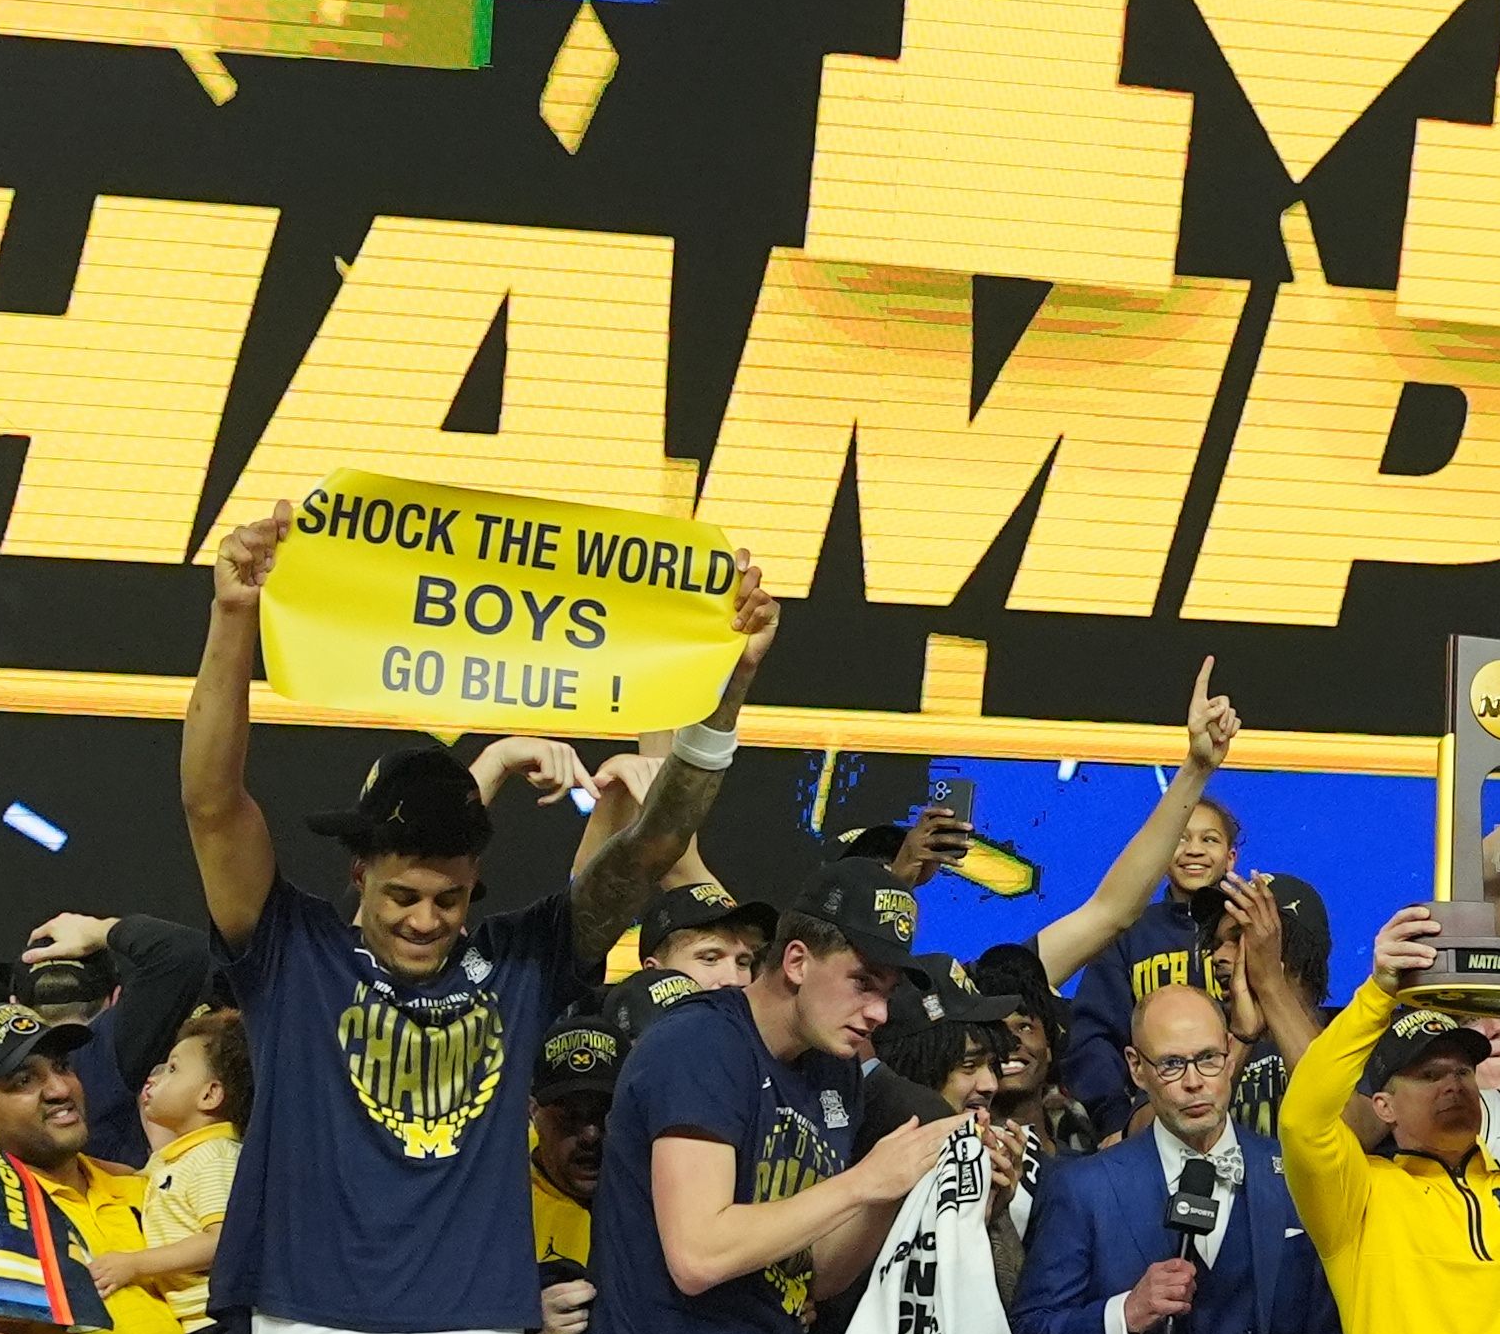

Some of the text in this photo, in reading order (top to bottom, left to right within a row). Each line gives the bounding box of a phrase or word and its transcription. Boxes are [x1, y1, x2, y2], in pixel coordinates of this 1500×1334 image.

[296, 488, 736, 597] SHOCK THE WORLD
[413, 574, 607, 649] BOYS
[382, 645, 621, 713] GO BLUE !
[403, 1122, 460, 1159] M
[959, 1163, 977, 1195] MEN'S
